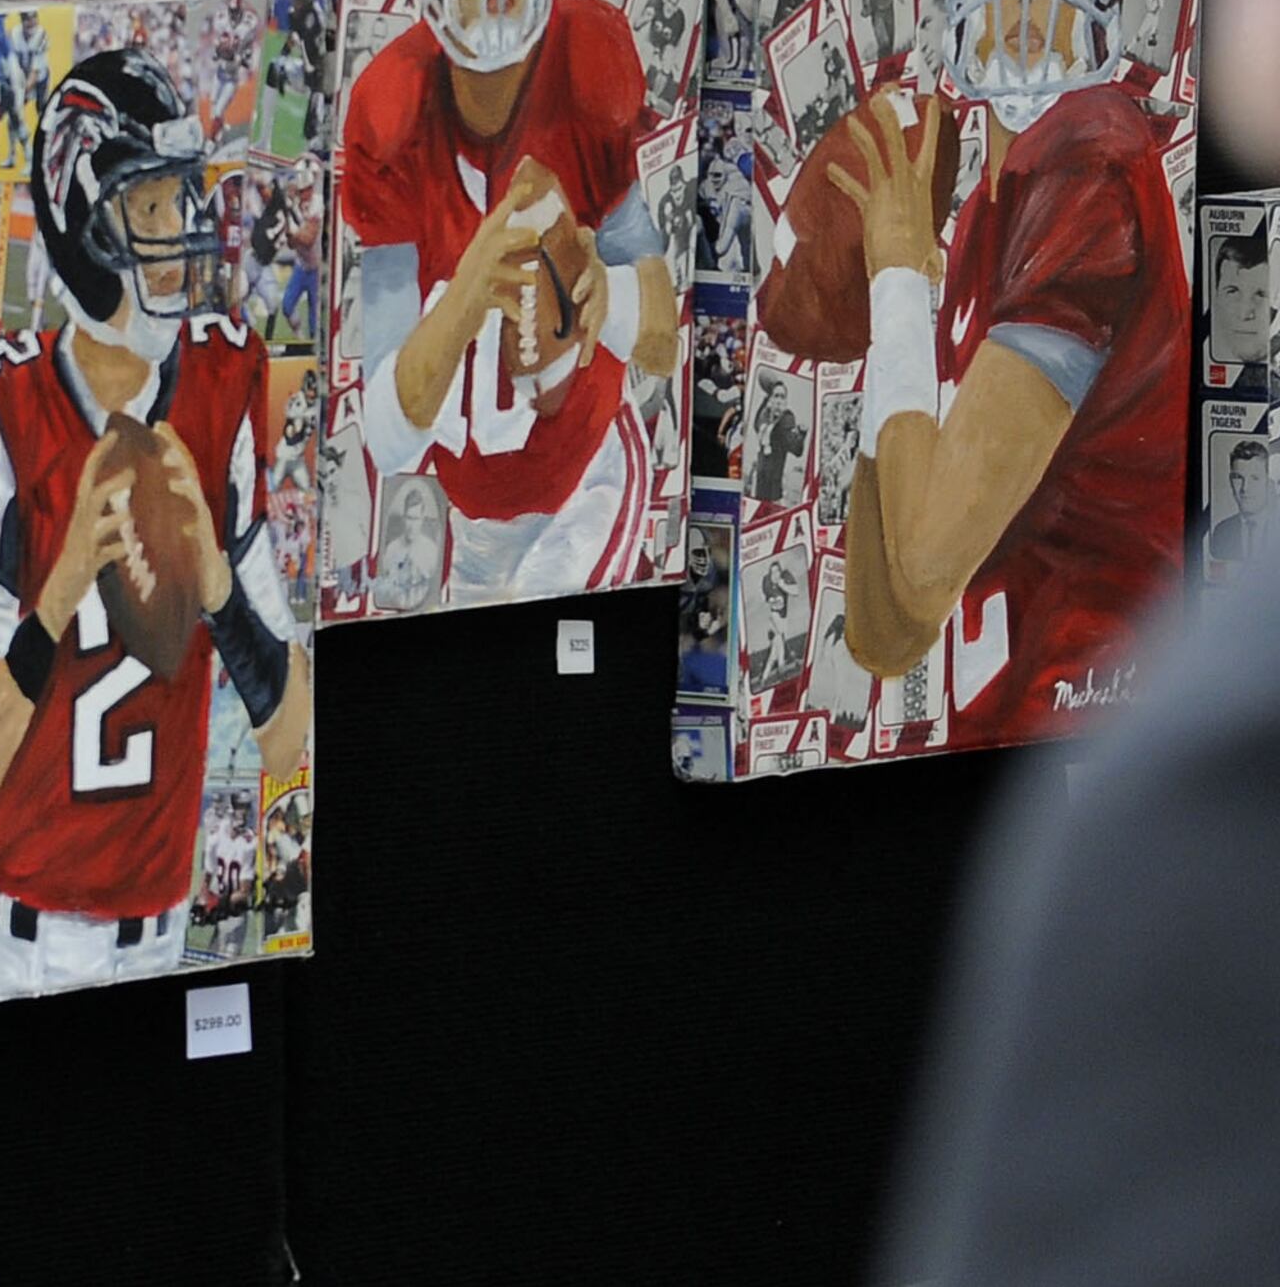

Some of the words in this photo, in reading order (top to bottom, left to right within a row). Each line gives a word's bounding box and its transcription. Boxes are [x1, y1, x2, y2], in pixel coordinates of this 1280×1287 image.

[1209, 210, 1245, 222] AUBURN
[1209, 221, 1241, 233] TIGERS
[1210, 404, 1247, 417] AUBURN
[1210, 416, 1242, 429] TIGERS
